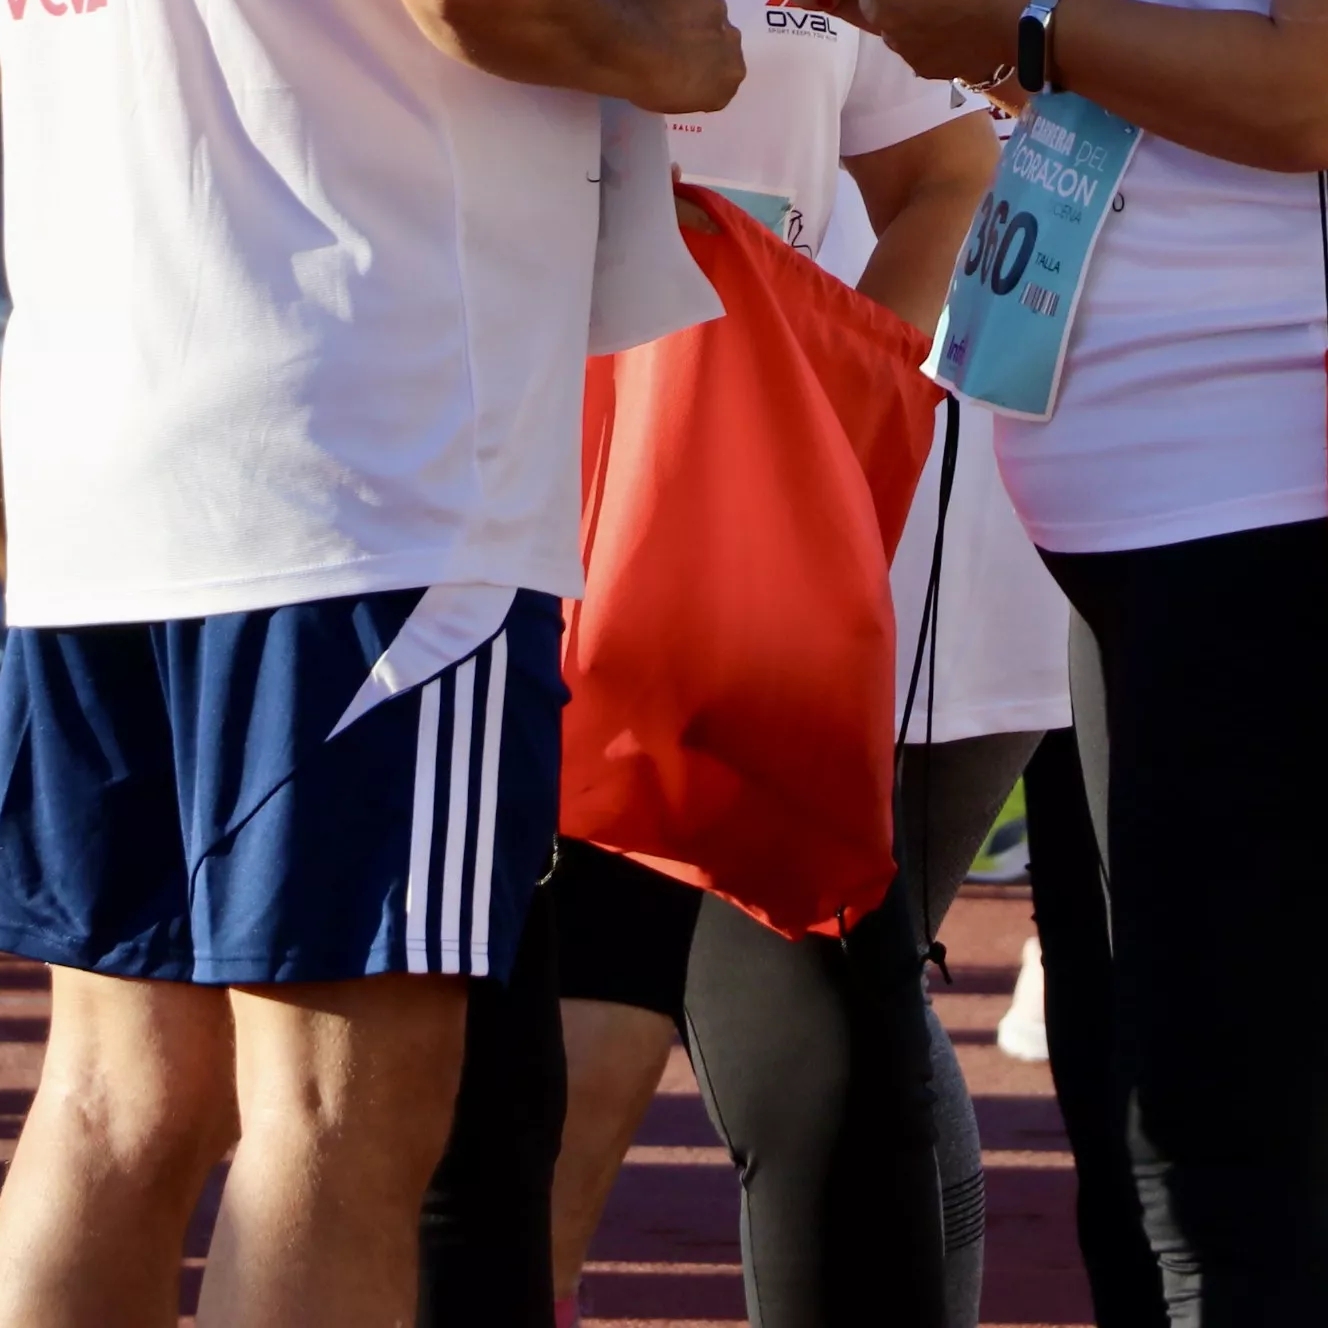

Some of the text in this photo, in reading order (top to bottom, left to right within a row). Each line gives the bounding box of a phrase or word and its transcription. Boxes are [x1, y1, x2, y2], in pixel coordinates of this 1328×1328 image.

[1075, 139, 1108, 172] DEL
[964, 191, 1038, 296] 360
[1035, 251, 1061, 274] TALLA
